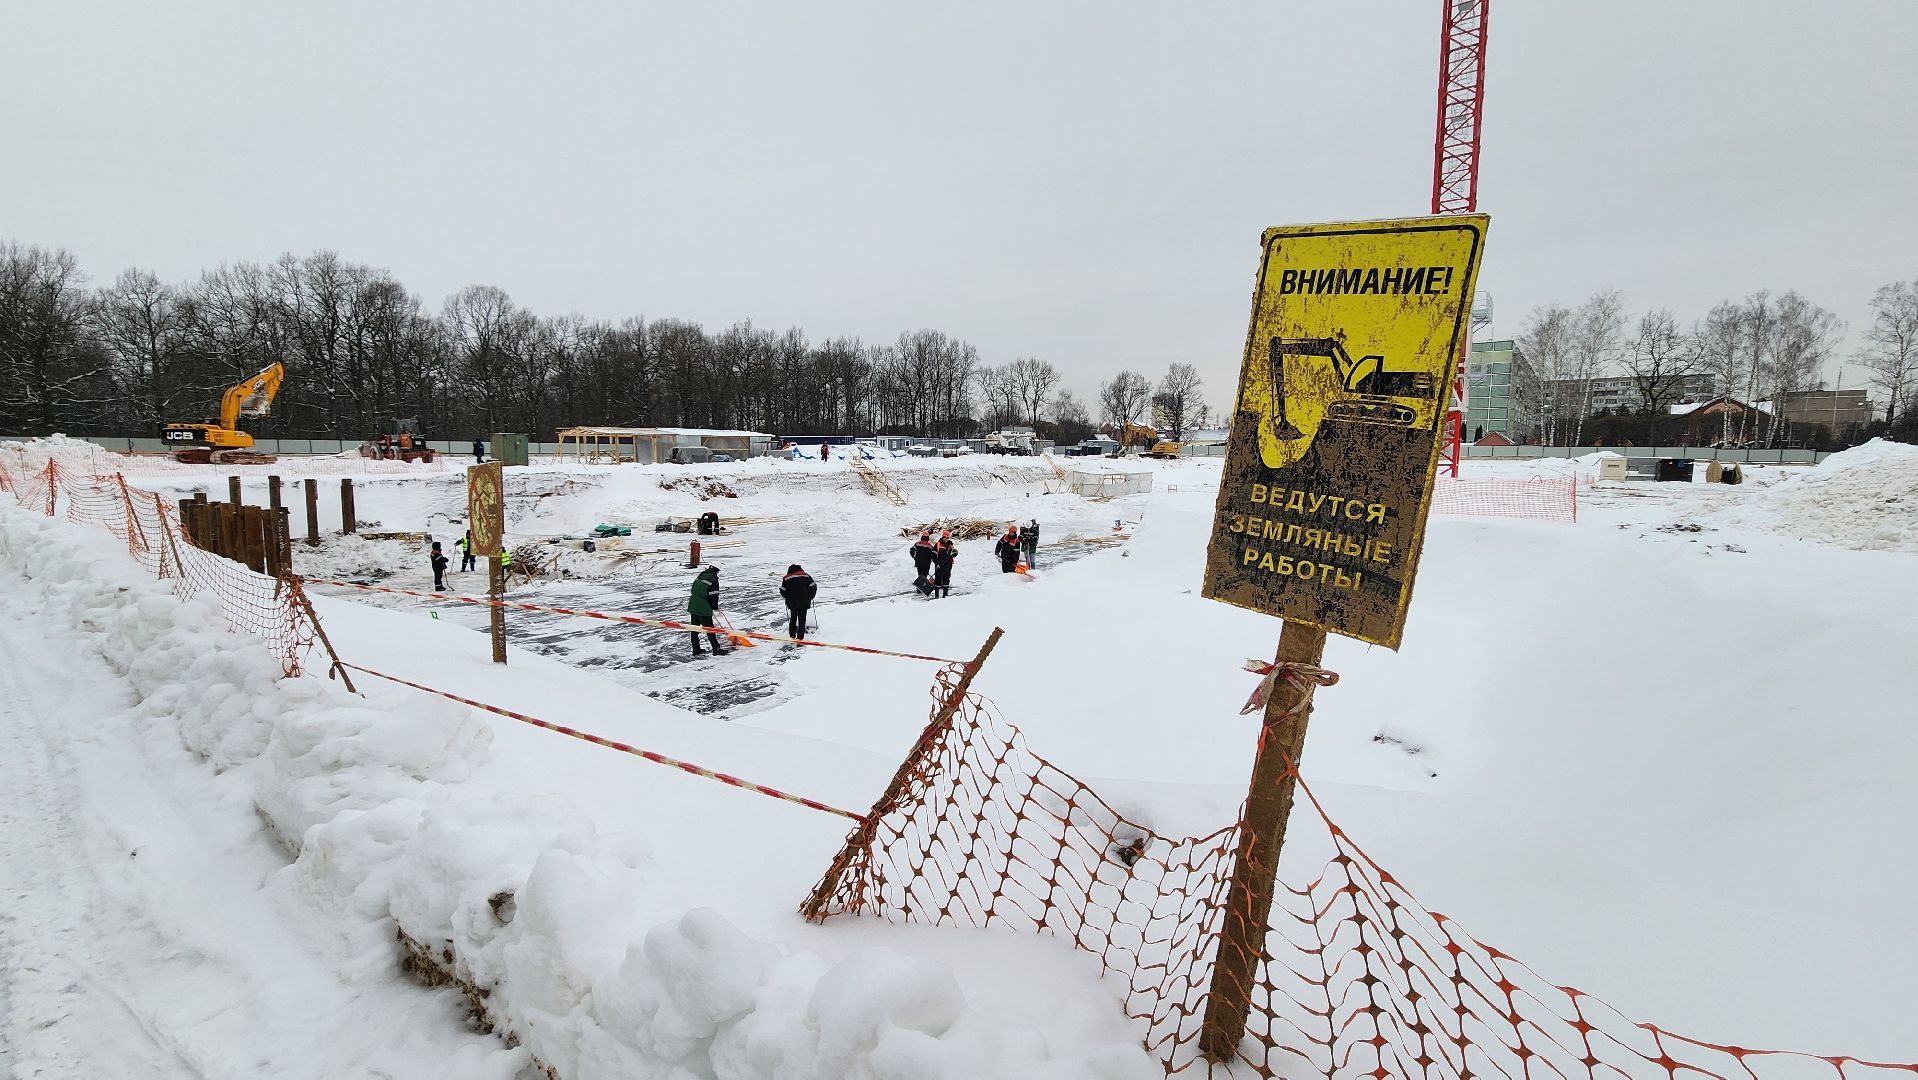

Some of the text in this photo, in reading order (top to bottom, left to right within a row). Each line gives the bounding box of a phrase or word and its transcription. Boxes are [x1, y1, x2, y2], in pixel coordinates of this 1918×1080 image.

[1280, 266, 1454, 296] ВНИМАНИЕ!
[166, 431, 194, 440] JCB
[1250, 483, 1388, 525] ВЕДУТСЯ
[1230, 514, 1393, 564] ЗЕМЛЯНЫЕ
[1243, 546, 1362, 592] РАБОТЫ
